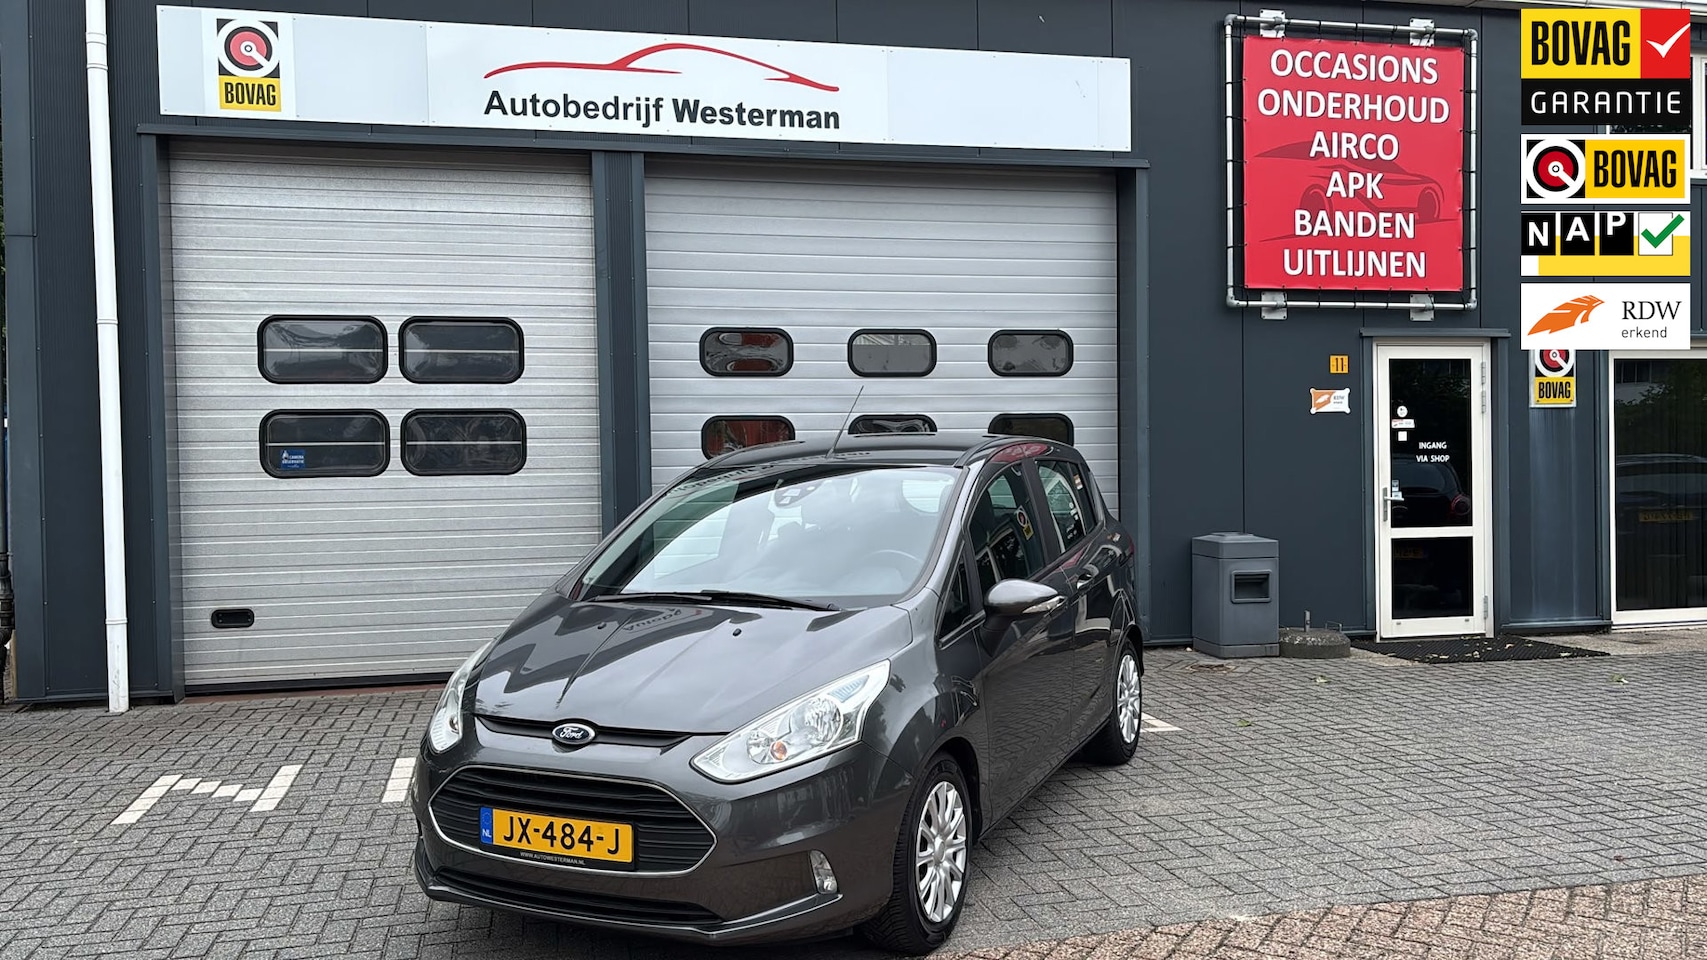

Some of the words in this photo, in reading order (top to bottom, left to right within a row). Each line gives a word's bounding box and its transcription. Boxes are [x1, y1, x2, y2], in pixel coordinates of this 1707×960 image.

[1270, 49, 1438, 85] OCCASIONS
[224, 82, 276, 106] BOVAG
[1258, 88, 1450, 125] ONDERHOUD
[484, 90, 664, 128] Autobedrijf
[672, 98, 840, 129] Westerman
[1309, 131, 1399, 162] AIRCO
[1325, 171, 1384, 200] APK
[1294, 209, 1415, 240] BANDEN
[1283, 249, 1426, 278] UITLIJNEN
[1335, 357, 1344, 372] 11
[1538, 381, 1571, 399] BOVAG
[1418, 441, 1447, 450] INGANG
[1430, 455, 1450, 463] SHOP
[560, 726, 584, 739] Ford
[482, 829, 492, 838] NL
[503, 816, 620, 855] JX-484-J
[520, 852, 586, 866] WWW.AUTOWESTERMAN.NL
